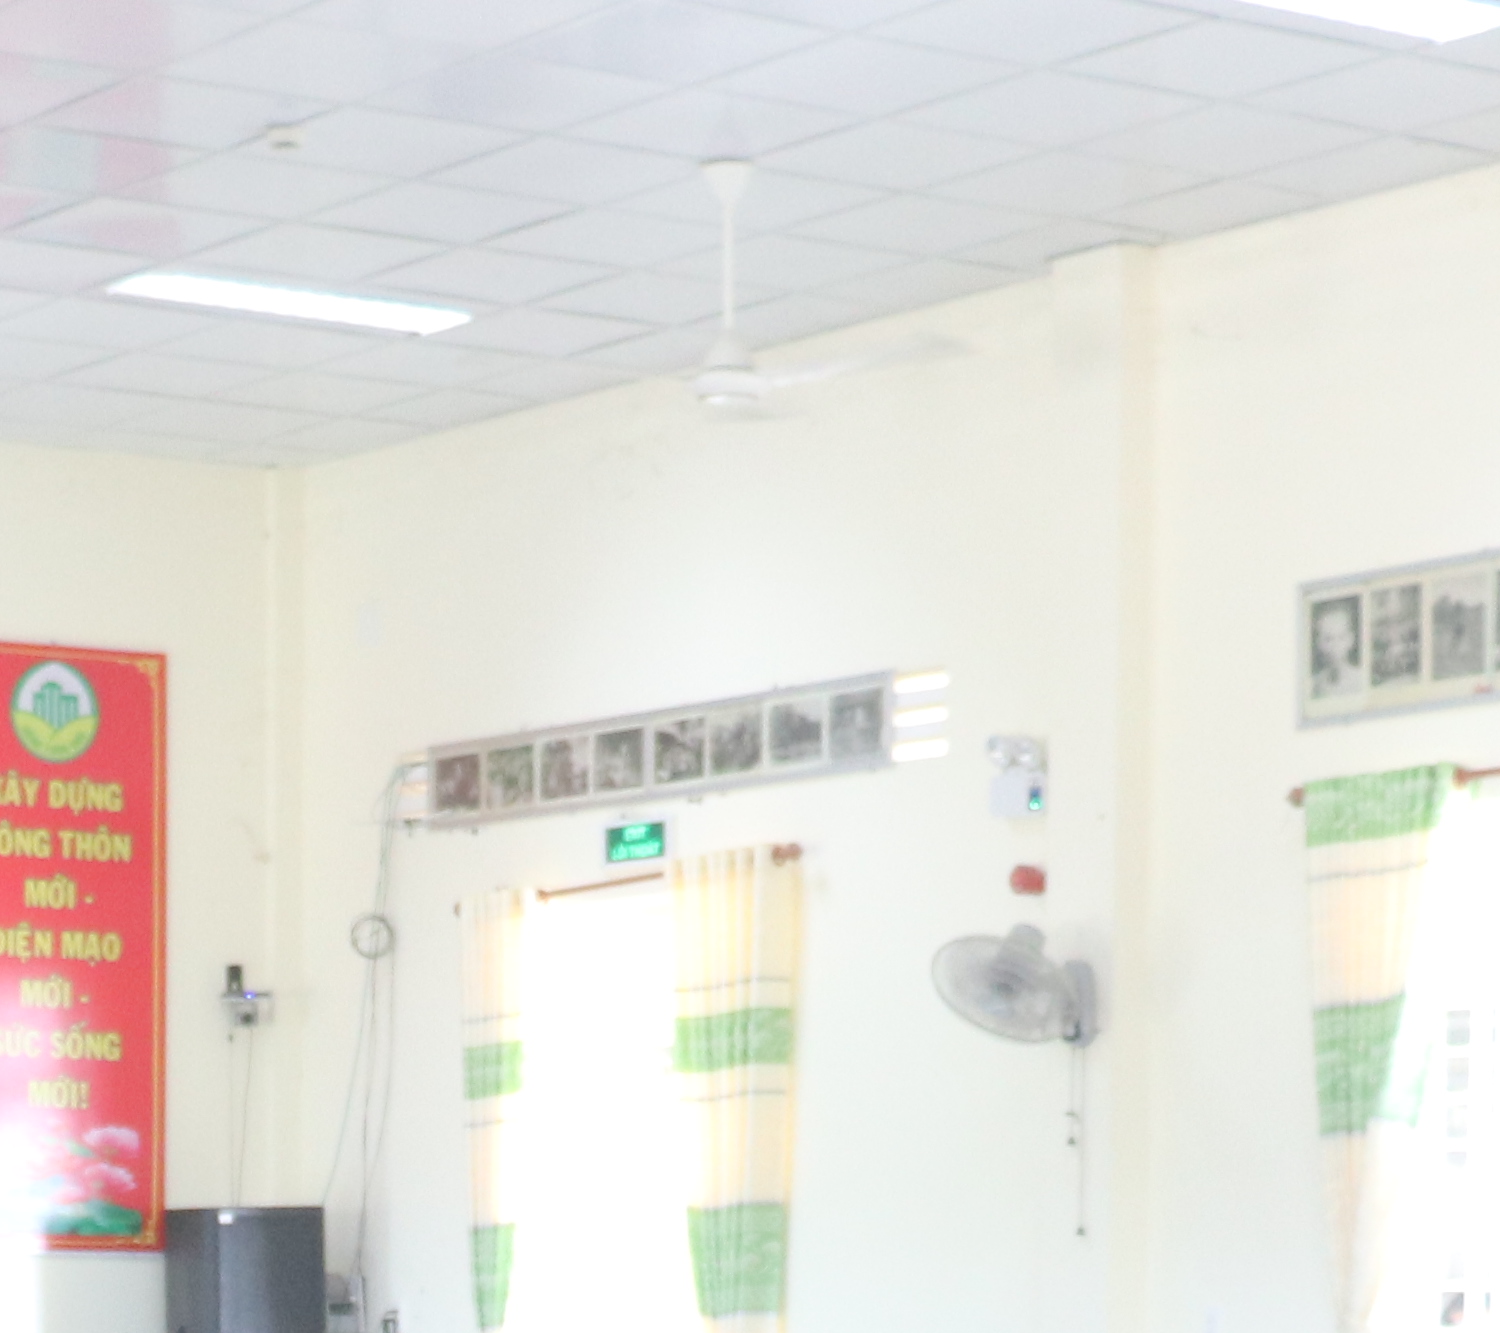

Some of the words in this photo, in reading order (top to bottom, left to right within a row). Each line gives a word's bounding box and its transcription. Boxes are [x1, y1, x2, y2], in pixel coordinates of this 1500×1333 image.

[48, 776, 124, 816] DỰNG
[58, 825, 132, 863] THÔN
[24, 873, 77, 910] MỚI
[60, 930, 122, 967] MẠO
[20, 973, 72, 1009] MỚI
[51, 1020, 122, 1061] SỐNG
